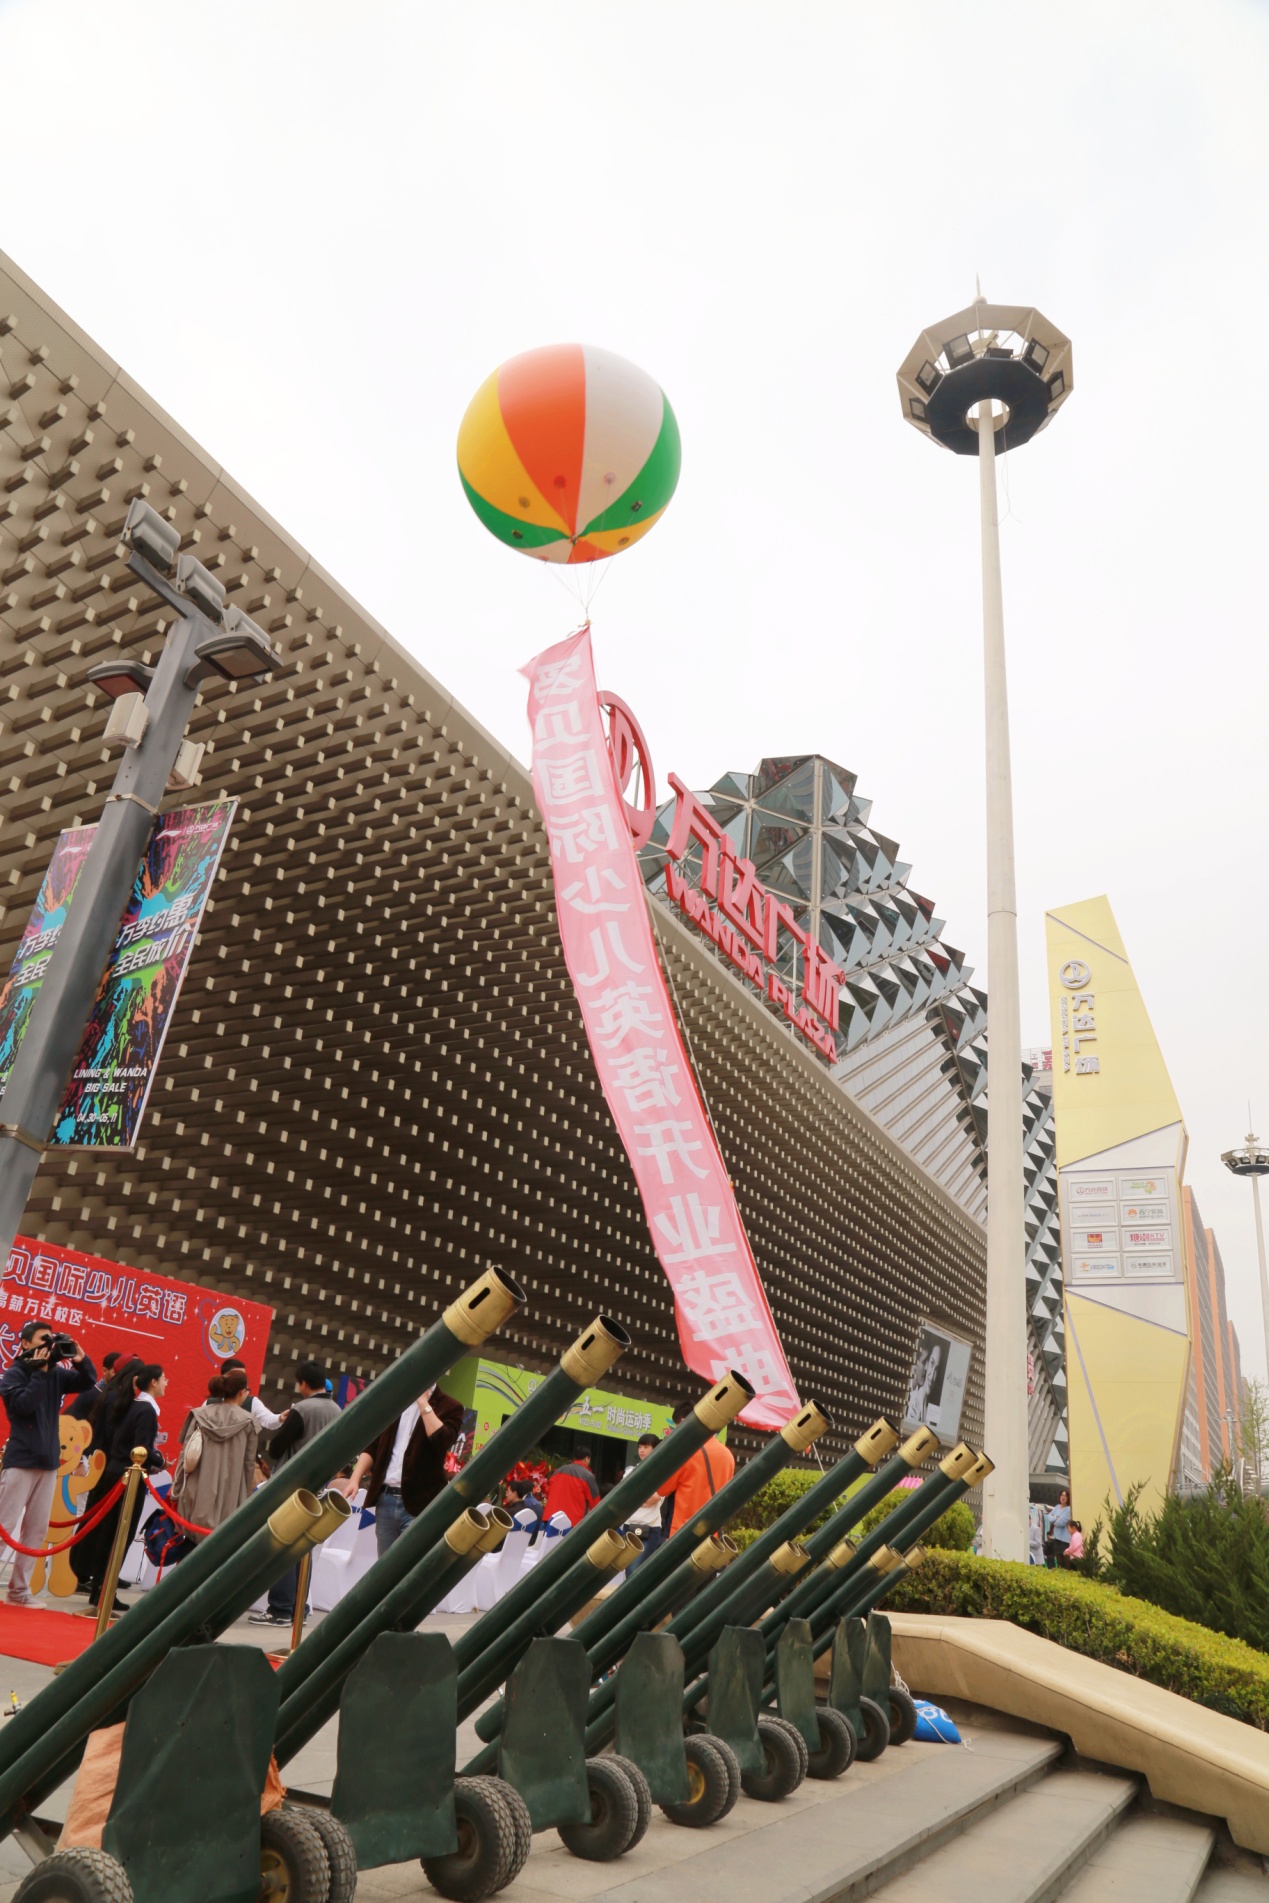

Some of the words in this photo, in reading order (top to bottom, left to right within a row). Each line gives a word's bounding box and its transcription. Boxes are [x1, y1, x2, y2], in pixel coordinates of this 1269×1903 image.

[666, 772, 840, 1032] 万达广场
[112, 923, 192, 978] 全民放价
[665, 863, 765, 990] WANDA
[769, 975, 838, 1065] PLAZA
[1060, 995, 1069, 1036] WANDA
[1071, 993, 1100, 1076] 万达广场
[73, 1069, 102, 1079] LINING
[103, 1068, 111, 1079] &
[113, 1067, 147, 1078] WANDA
[1063, 1036, 1071, 1074] PLAZA
[84, 1083, 101, 1093] BIG
[102, 1082, 128, 1093] SALE
[607, 1406, 652, 1431] 时尚运动季
